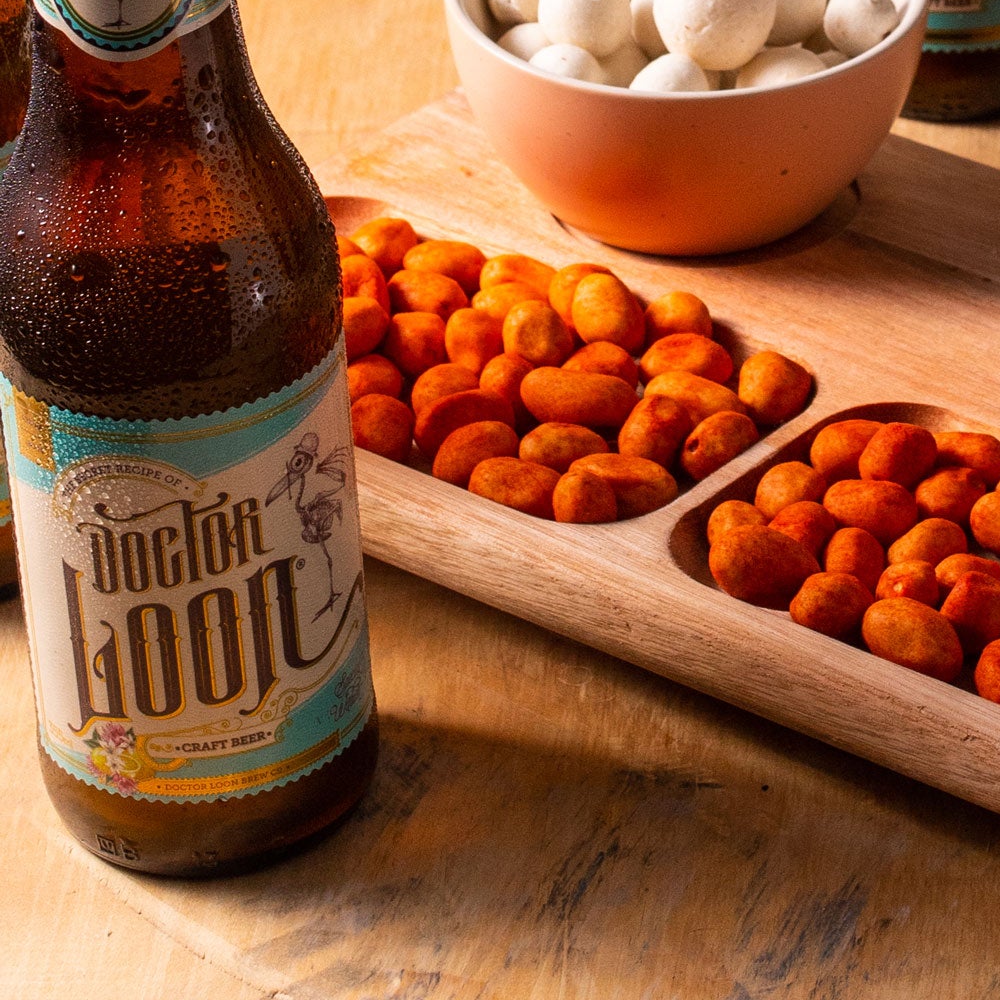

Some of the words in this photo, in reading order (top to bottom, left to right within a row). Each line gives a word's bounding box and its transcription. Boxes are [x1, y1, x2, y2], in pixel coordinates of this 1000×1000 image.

[115, 464, 162, 480] RECIPE
[164, 474, 182, 487] OF
[182, 739, 229, 753] CRAFT
[231, 731, 267, 748] BEER
[165, 782, 208, 791] DOCTOR
[210, 779, 239, 789] LOON
[241, 771, 269, 784] BREW
